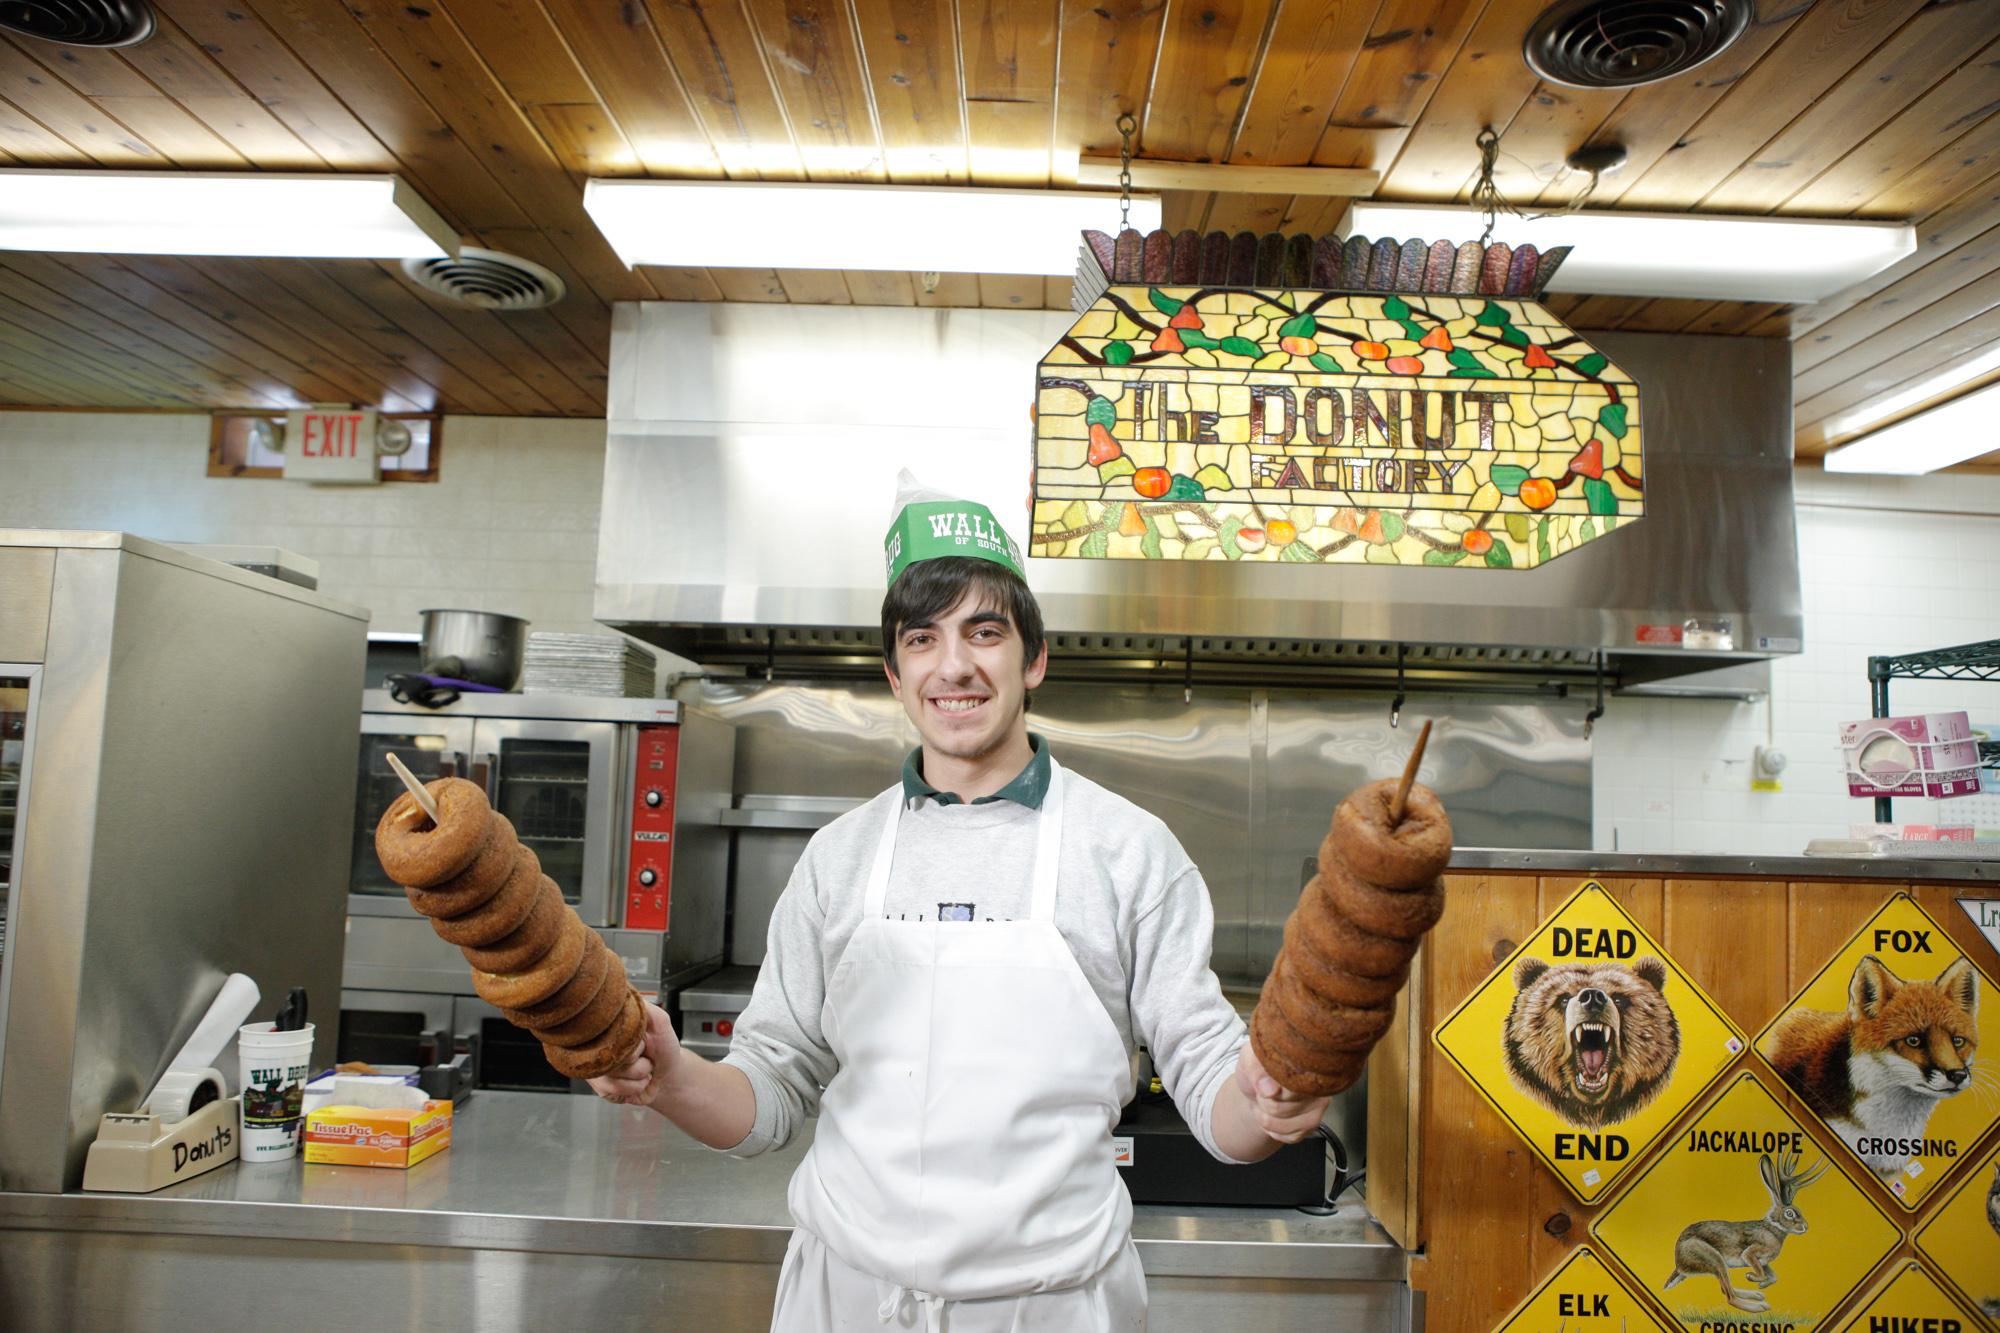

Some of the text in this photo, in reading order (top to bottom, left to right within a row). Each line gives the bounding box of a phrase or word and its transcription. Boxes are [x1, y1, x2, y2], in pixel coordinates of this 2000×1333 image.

[1250, 386, 1511, 451] DONUT
[303, 415, 364, 458] EXIT
[1250, 455, 1467, 493] FACTORY
[928, 512, 1000, 544] WALL
[955, 537, 1008, 557] OF SOUTH
[1979, 902, 2000, 933] Lr
[1552, 927, 1637, 959] DEAD
[1874, 929, 1933, 954] FOX
[251, 1067, 282, 1085] WALL
[172, 1125, 232, 1173] Donuts
[1554, 1133, 1630, 1161] END
[1688, 1130, 1804, 1154] JACKALOPE
[1856, 1136, 1957, 1157] CROSSING
[1558, 1294, 1610, 1318] ELK
